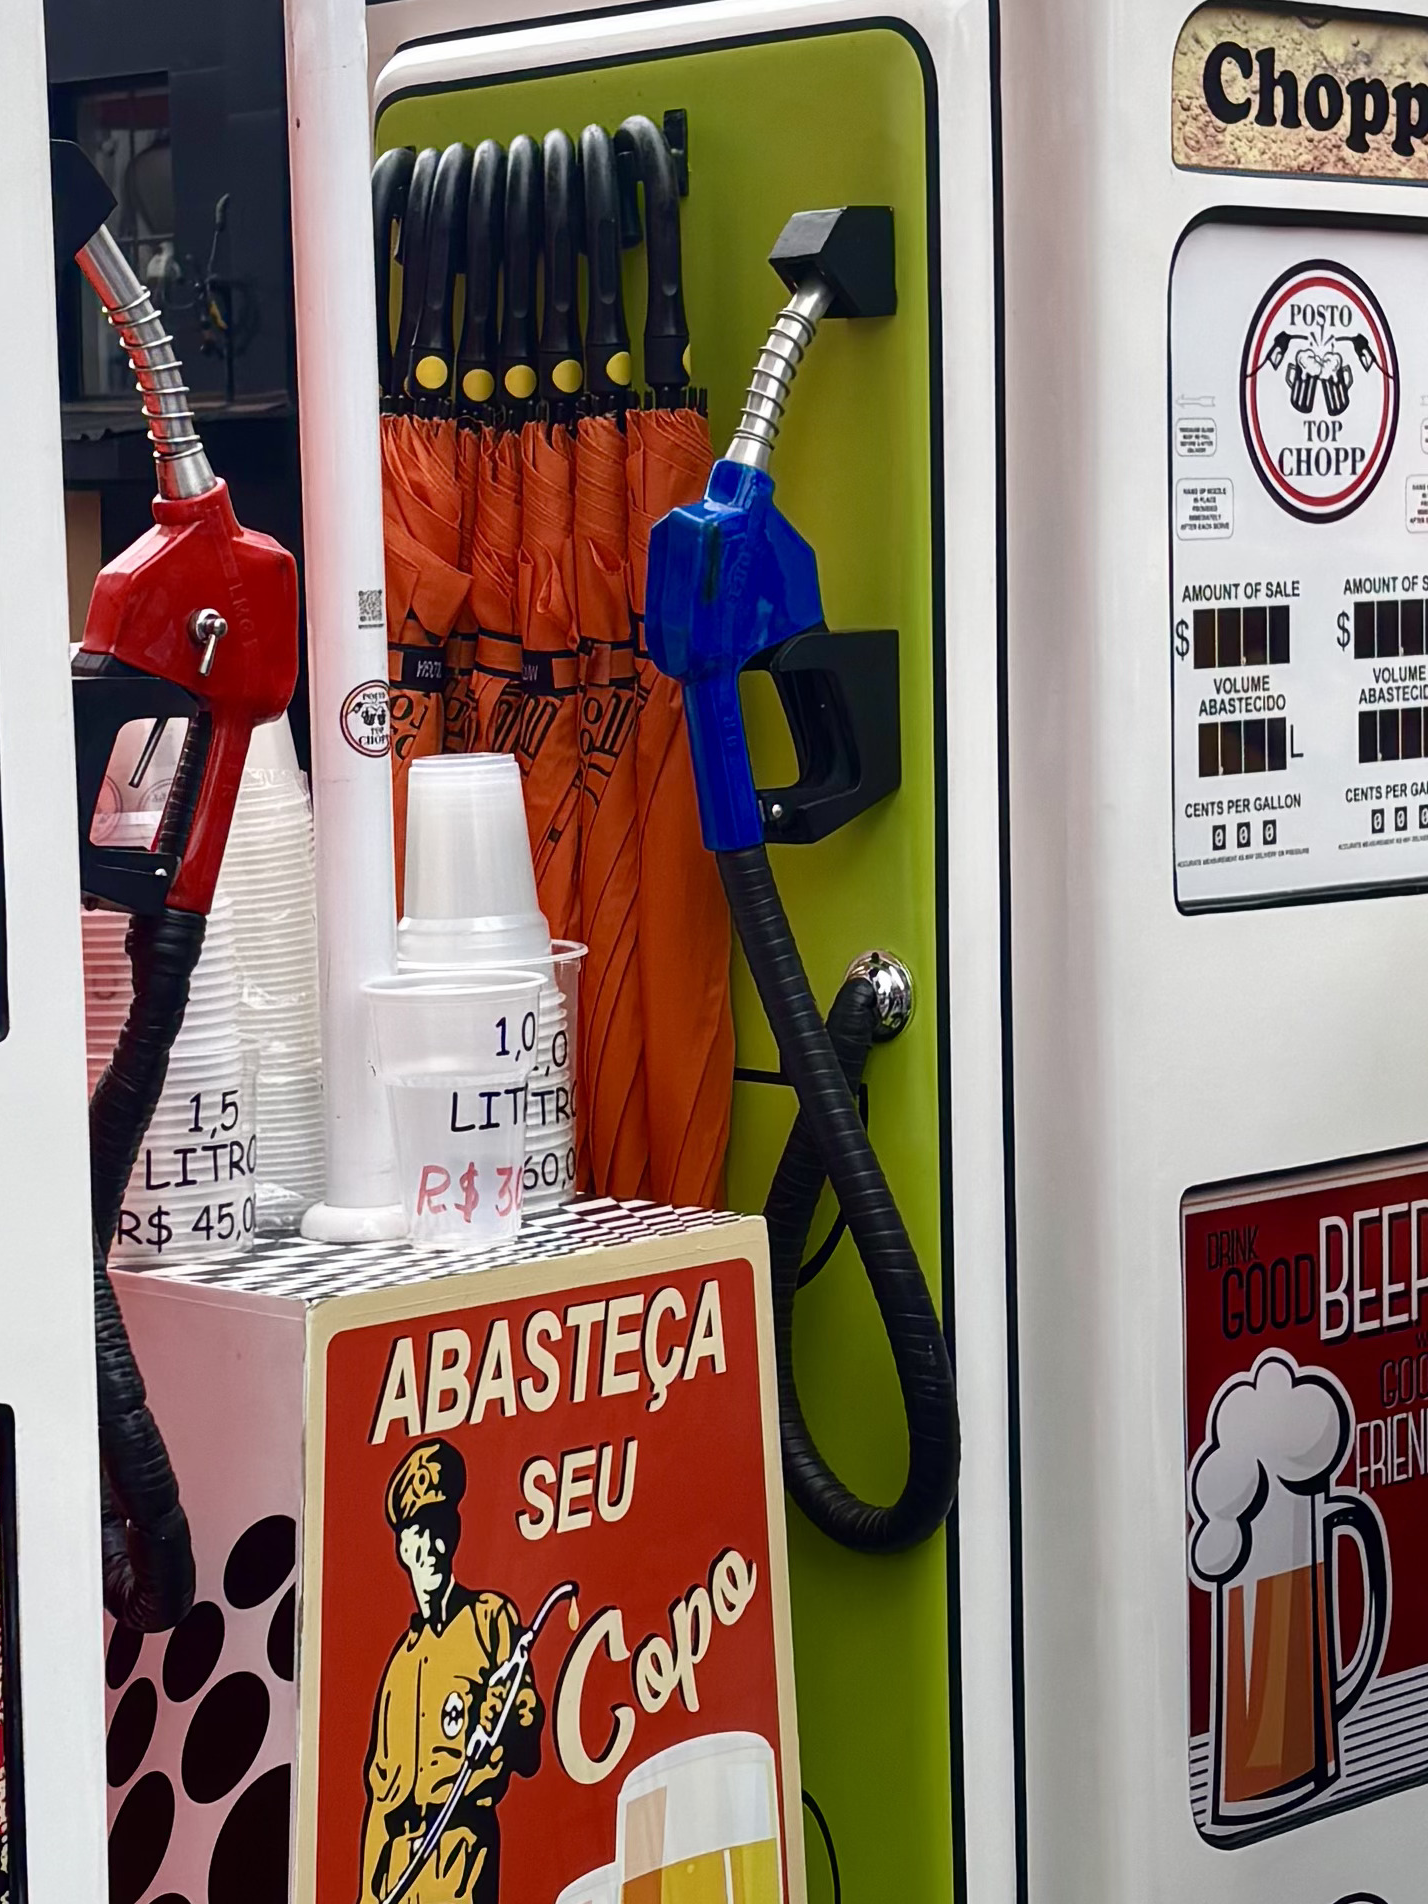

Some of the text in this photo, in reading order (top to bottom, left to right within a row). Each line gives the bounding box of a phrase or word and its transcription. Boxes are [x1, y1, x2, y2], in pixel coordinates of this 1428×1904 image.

[1289, 303, 1353, 328] POSTO
[1303, 420, 1343, 442] TOP
[1279, 445, 1366, 478] CHOPP
[1182, 580, 1300, 603] AMOUNT OF SALE
[1343, 577, 1399, 595] AMOUNT
[1402, 576, 1419, 591] OF
[1175, 618, 1190, 661] $
[1337, 610, 1351, 652] $
[1214, 675, 1270, 695] VOLUME
[1373, 665, 1427, 684] VOLUME
[1199, 695, 1286, 717] ABASTECIDO
[1290, 724, 1304, 758] L
[1185, 794, 1301, 819] CENTS PER GALLON
[1346, 786, 1382, 802] CENTS
[1385, 783, 1407, 799] PER
[496, 1011, 536, 1062] 1,0
[188, 1090, 239, 1139] 1,5
[146, 1134, 257, 1190] LITRO
[416, 1161, 479, 1223] R$
[117, 1205, 173, 1254] R$
[1207, 1224, 1259, 1271] DRINK
[1222, 1254, 1316, 1340] GOOD
[372, 1280, 727, 1445] ABASTEÇA
[518, 1440, 638, 1541] SEU
[555, 1549, 757, 1785] Copo
